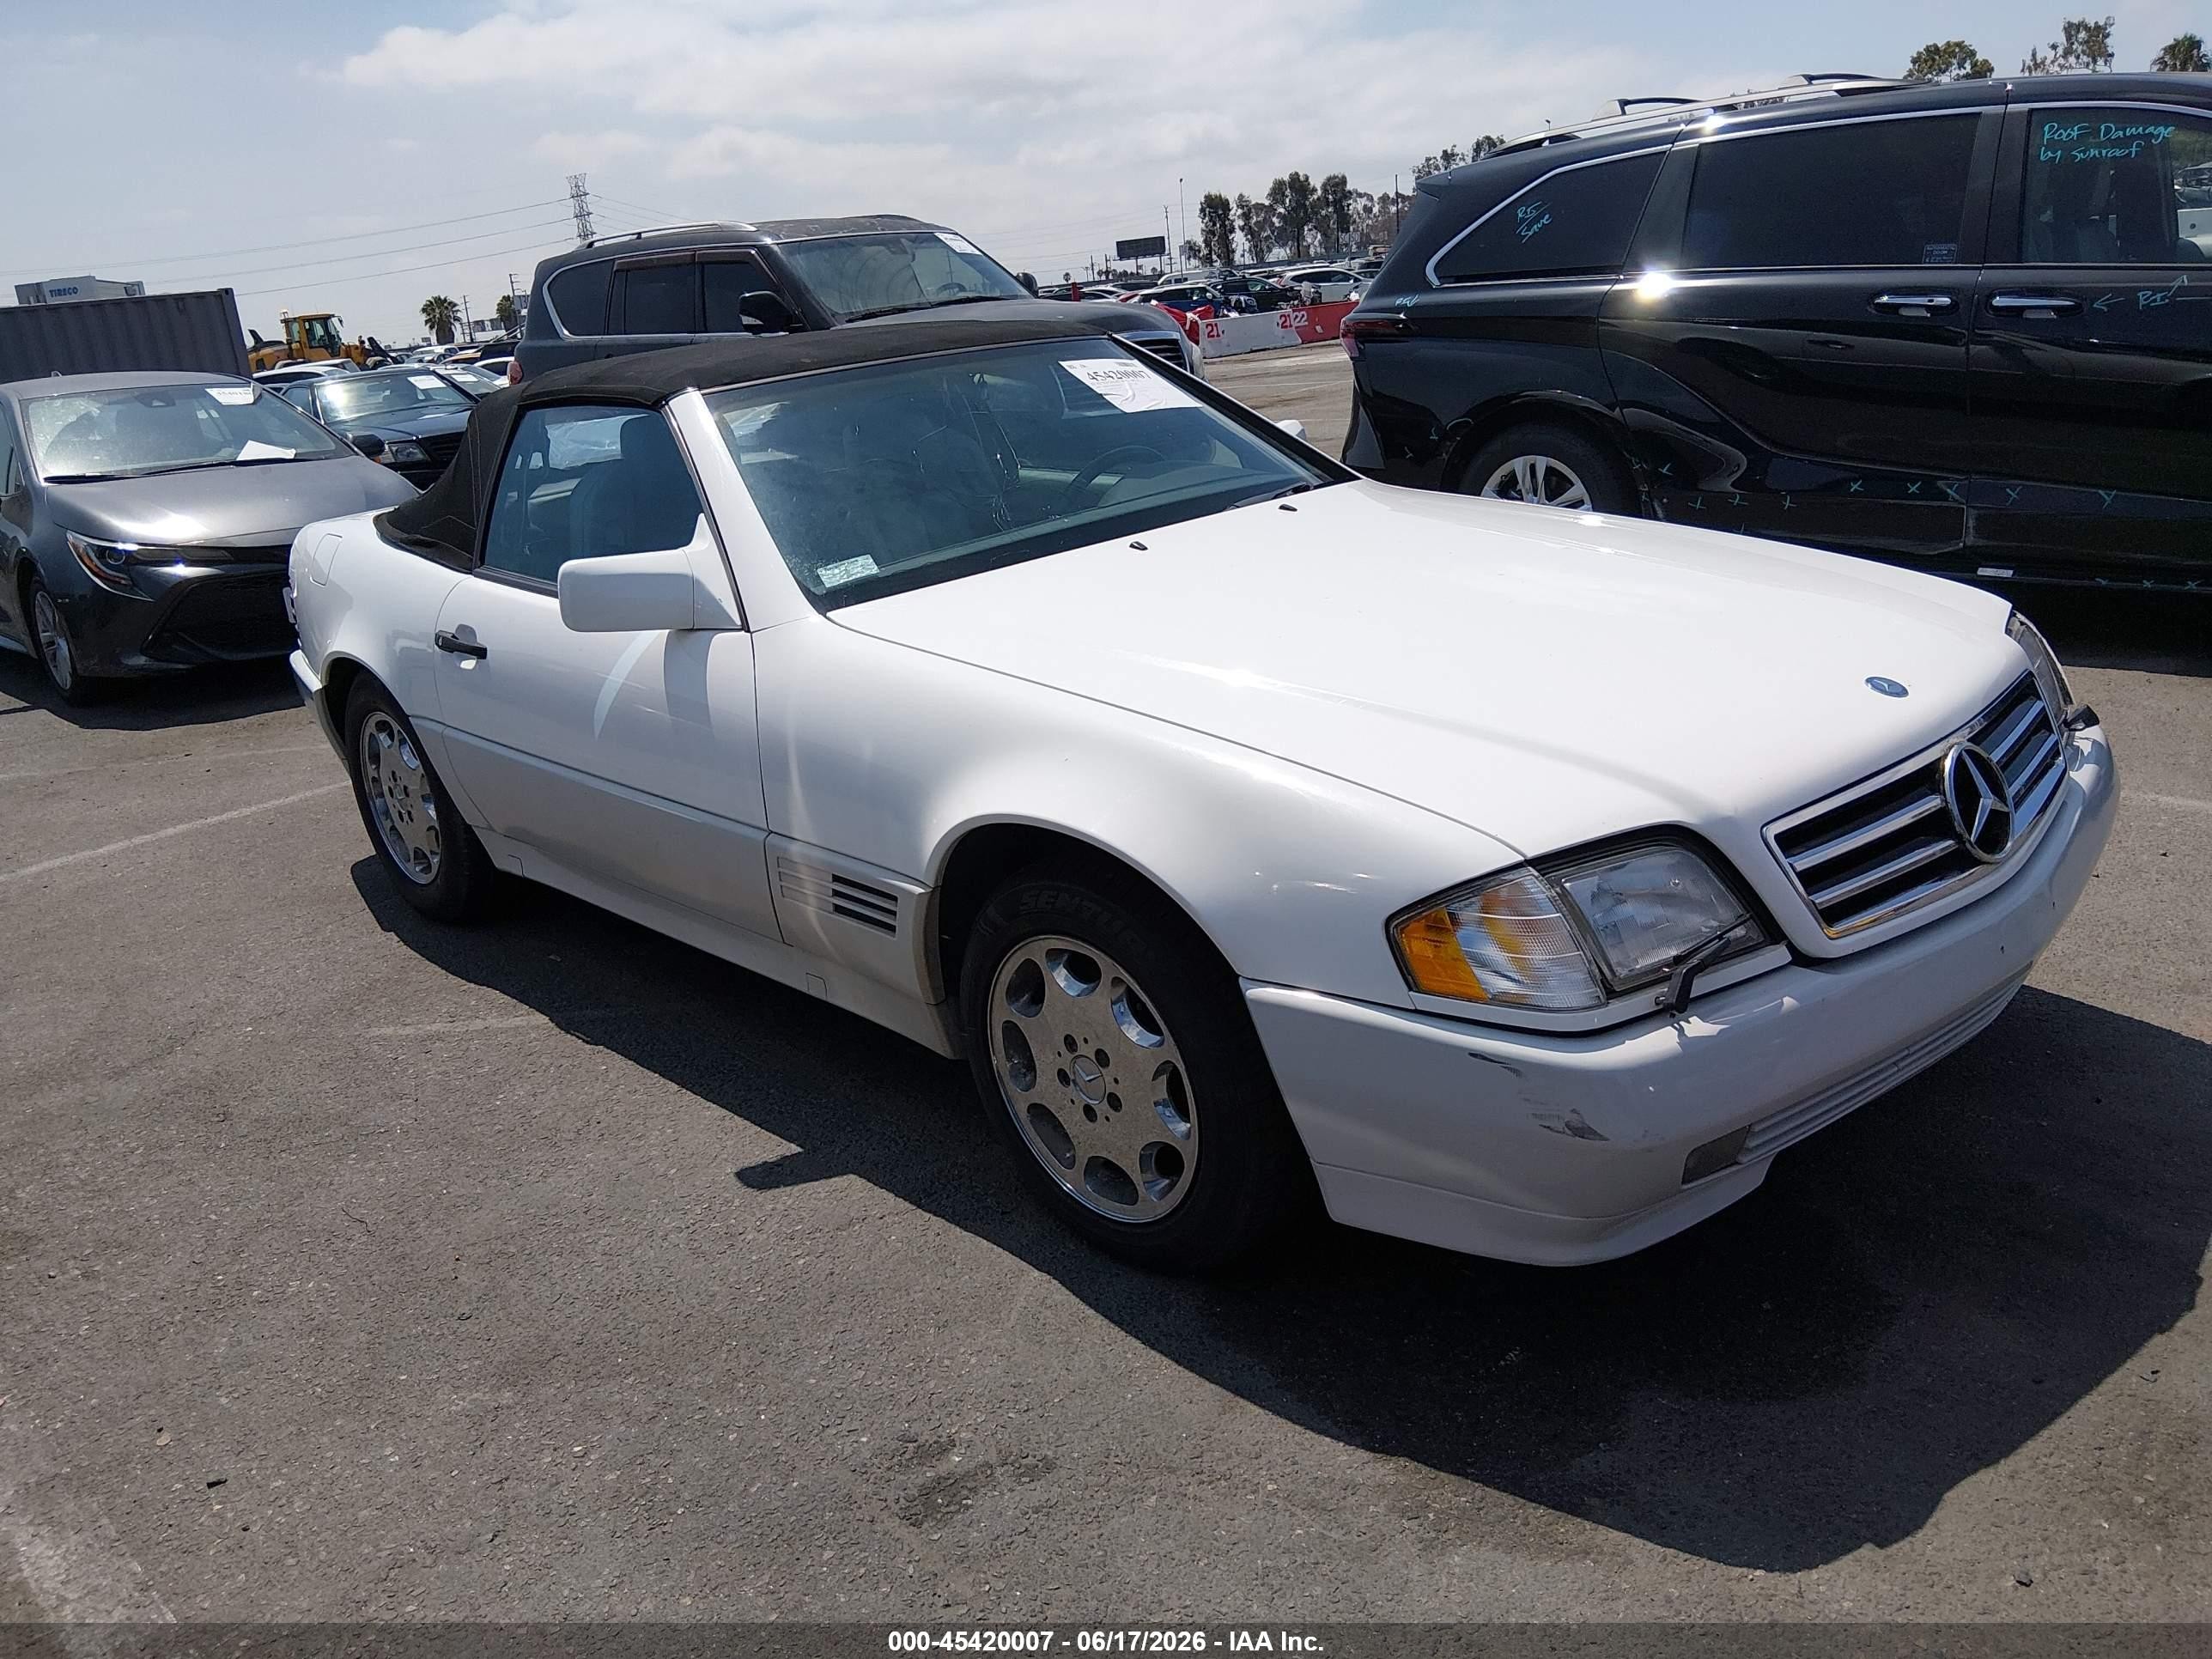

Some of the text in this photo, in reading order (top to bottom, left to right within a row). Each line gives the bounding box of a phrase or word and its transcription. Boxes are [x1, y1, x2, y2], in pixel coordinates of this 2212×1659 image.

[2100, 123, 2176, 144] Damage
[2039, 147, 2061, 164] by
[1279, 313, 1292, 329] 21
[1292, 311, 1309, 326] 22
[1206, 323, 1221, 338] 21
[1086, 369, 1152, 381] 45420007
